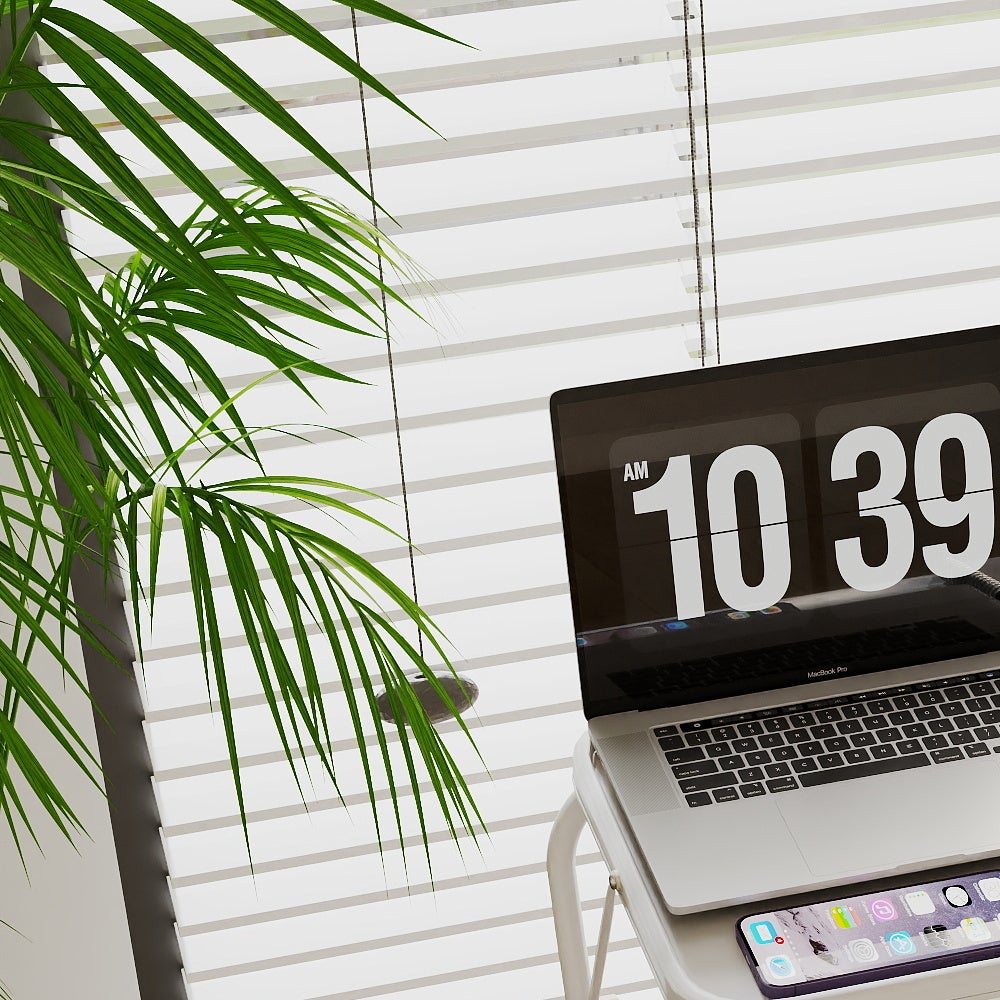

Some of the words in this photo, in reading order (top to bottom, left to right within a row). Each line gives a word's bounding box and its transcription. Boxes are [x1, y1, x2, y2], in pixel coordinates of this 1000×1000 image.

[623, 461, 649, 482] AM
[632, 444, 792, 621] 10
[830, 412, 995, 592] 39
[807, 667, 836, 679] MacBook
[836, 665, 848, 674] Pro
